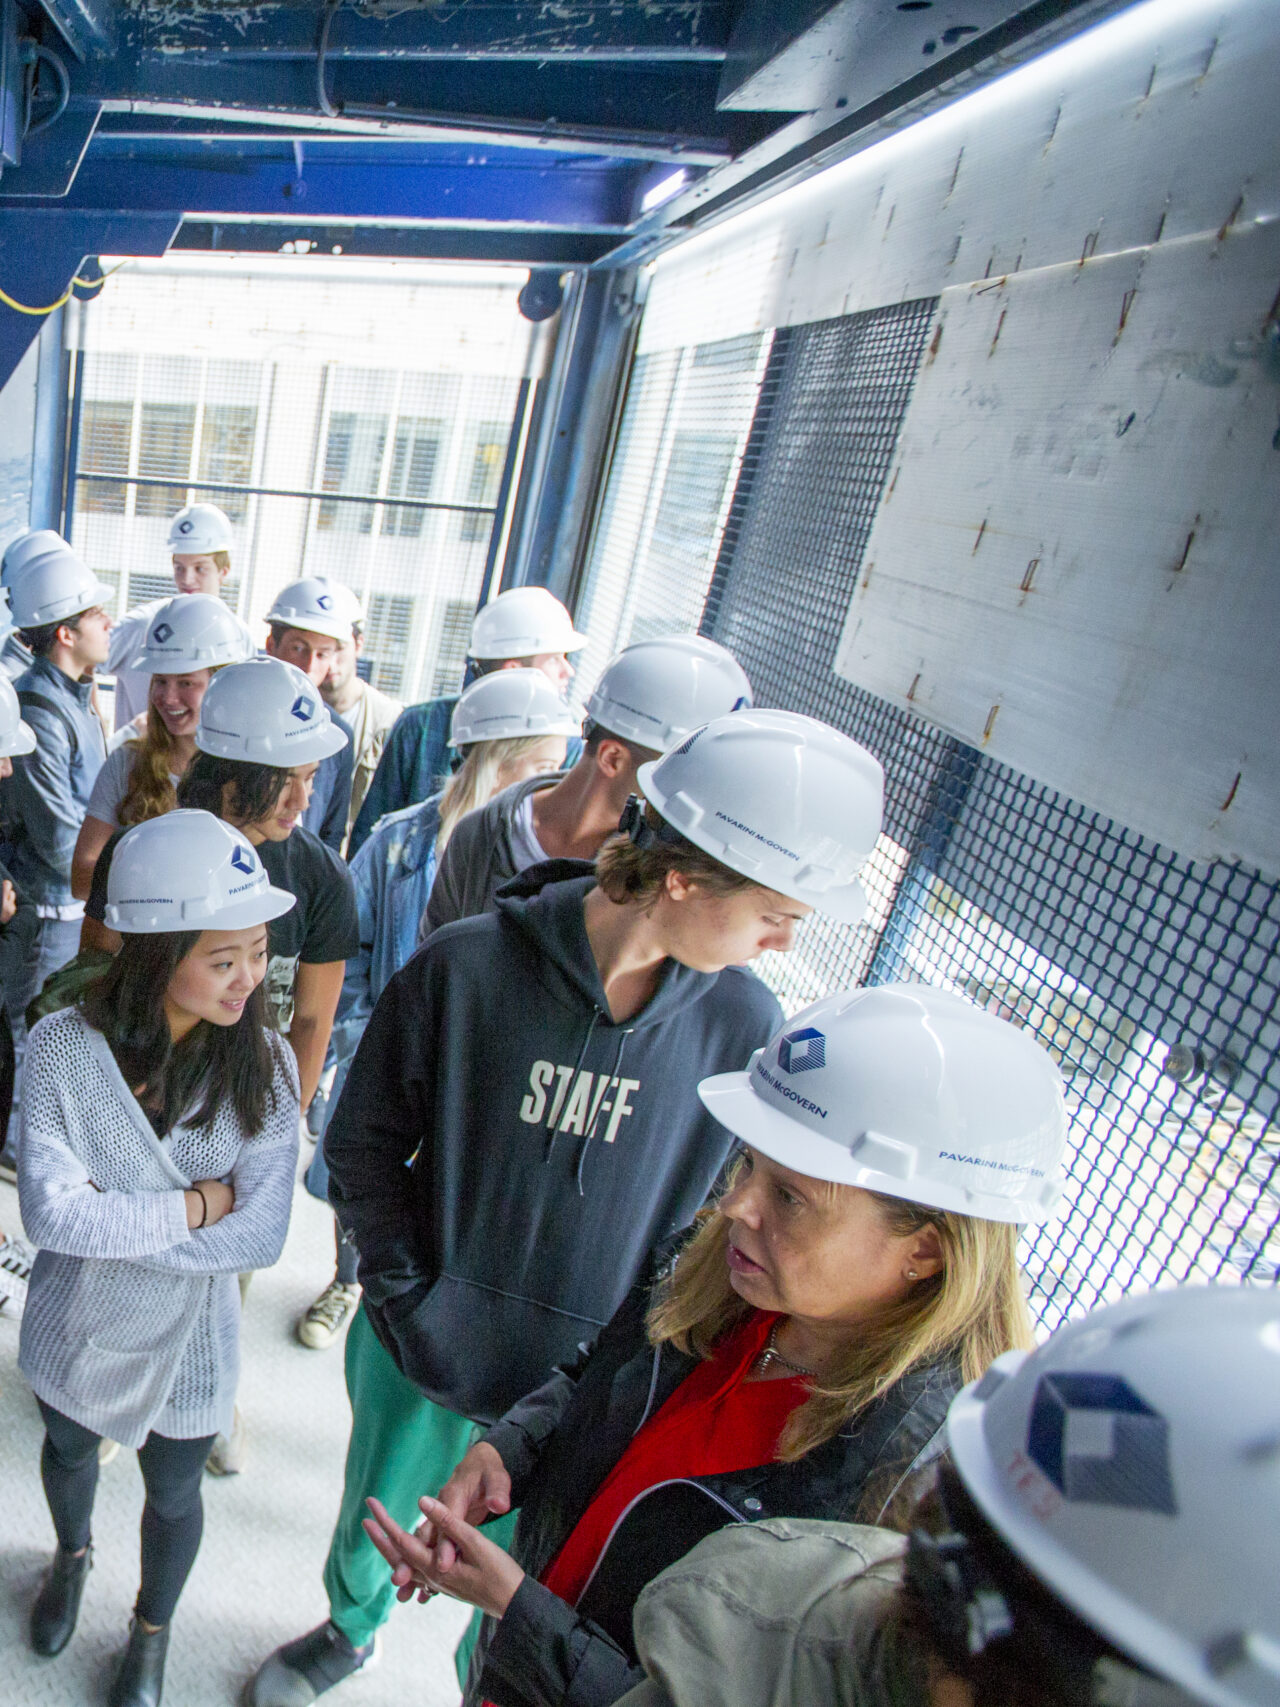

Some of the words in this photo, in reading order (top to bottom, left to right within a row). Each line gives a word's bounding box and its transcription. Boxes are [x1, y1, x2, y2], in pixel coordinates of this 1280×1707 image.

[715, 811, 756, 836] PAVARINI
[755, 834, 800, 862] McGOVERN
[520, 1060, 640, 1143] STAFF
[774, 1079, 828, 1119] McGOVERN
[939, 1150, 998, 1169] PAVARINI
